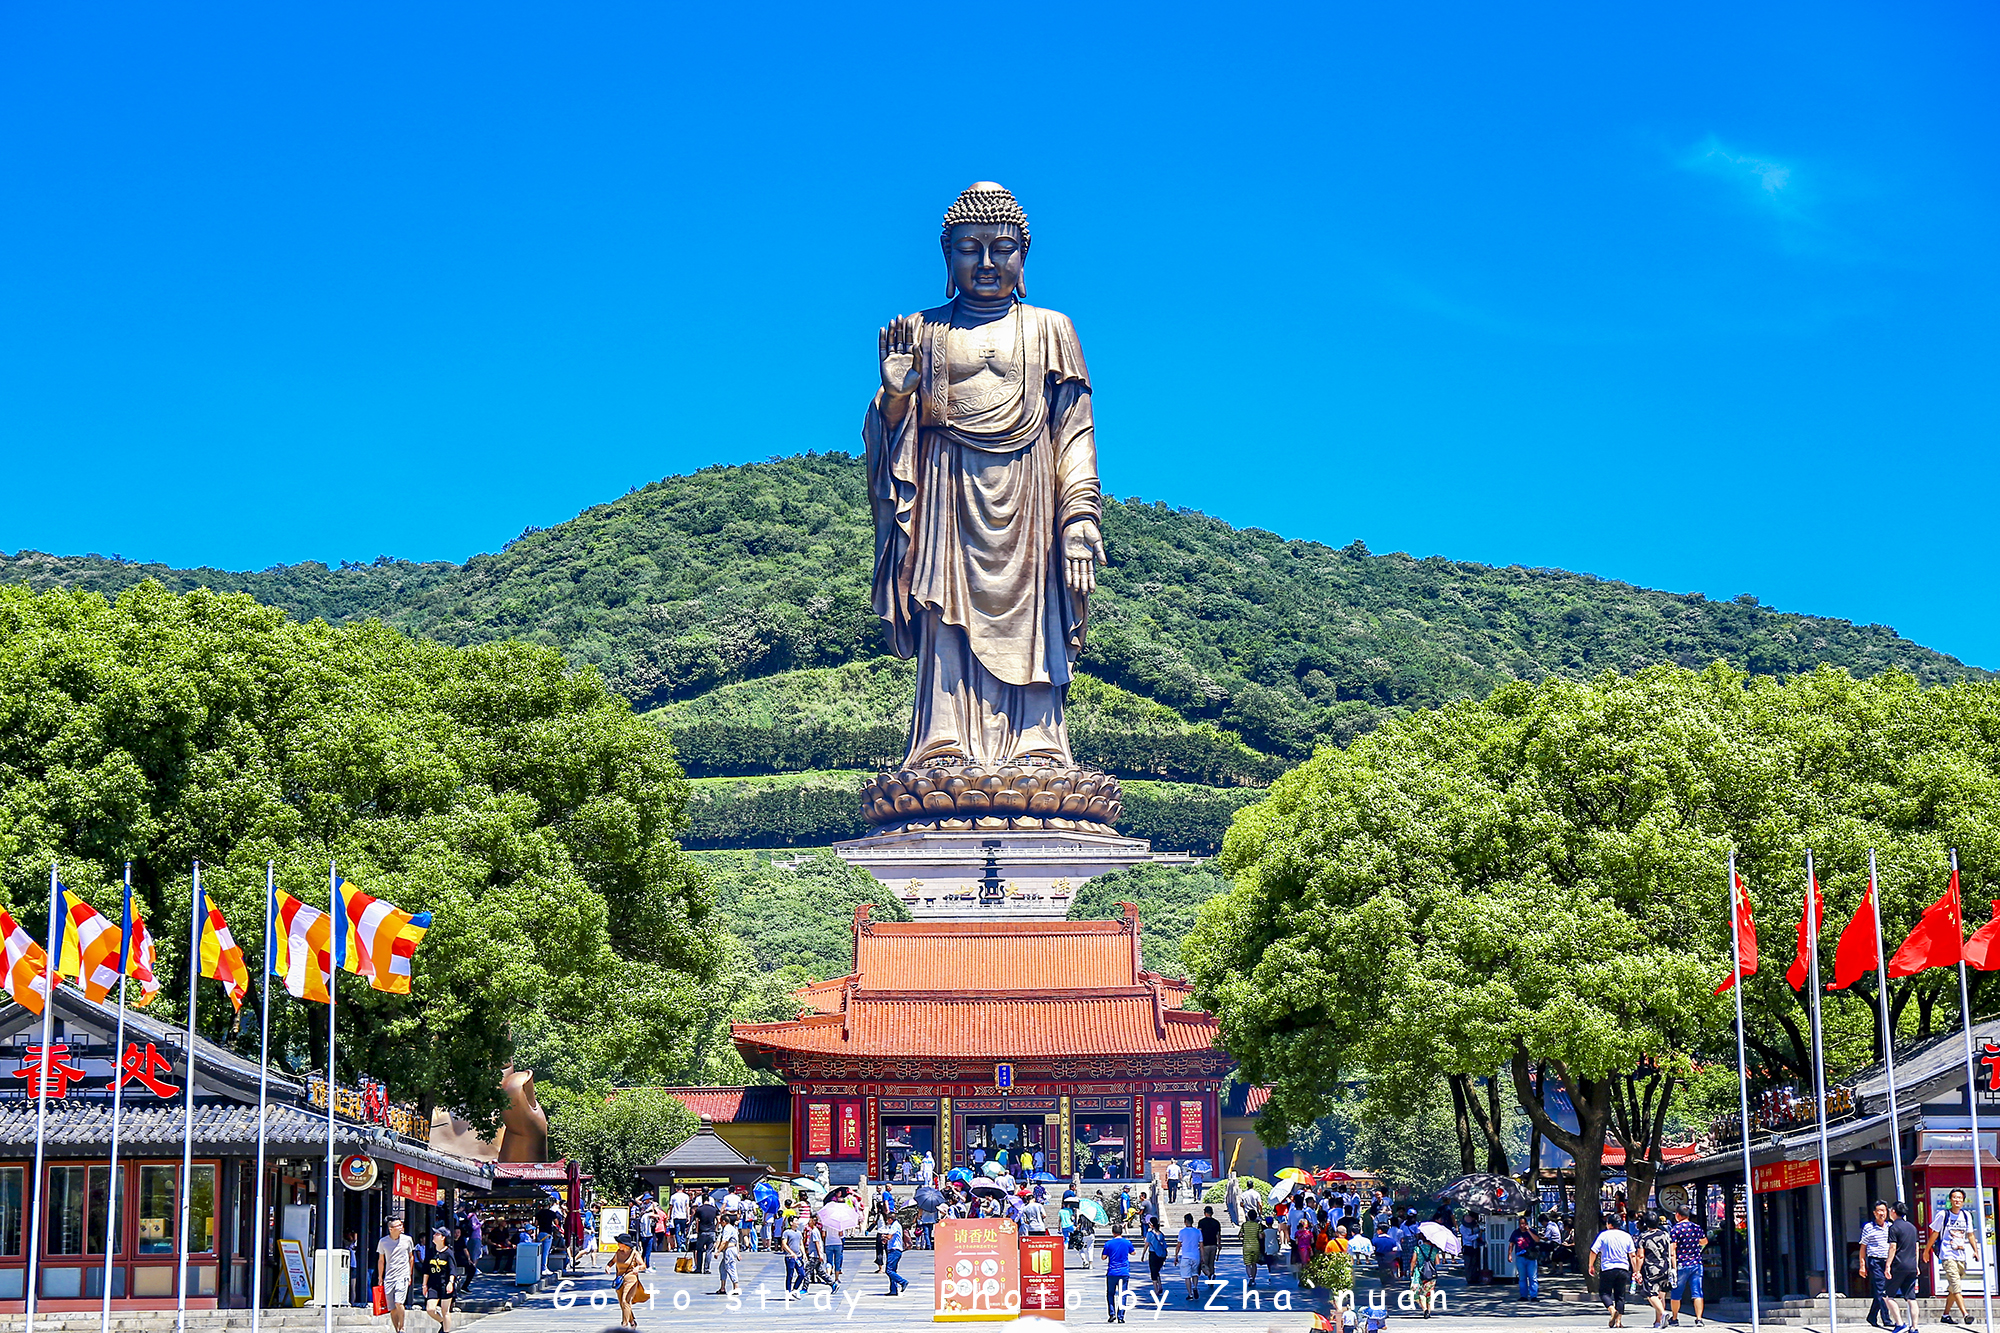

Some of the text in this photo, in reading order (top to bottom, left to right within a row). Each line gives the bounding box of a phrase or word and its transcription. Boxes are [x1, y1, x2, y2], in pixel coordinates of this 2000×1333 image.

[1665, 1190, 1684, 1206] 茶
[953, 1228, 998, 1243] 请香处
